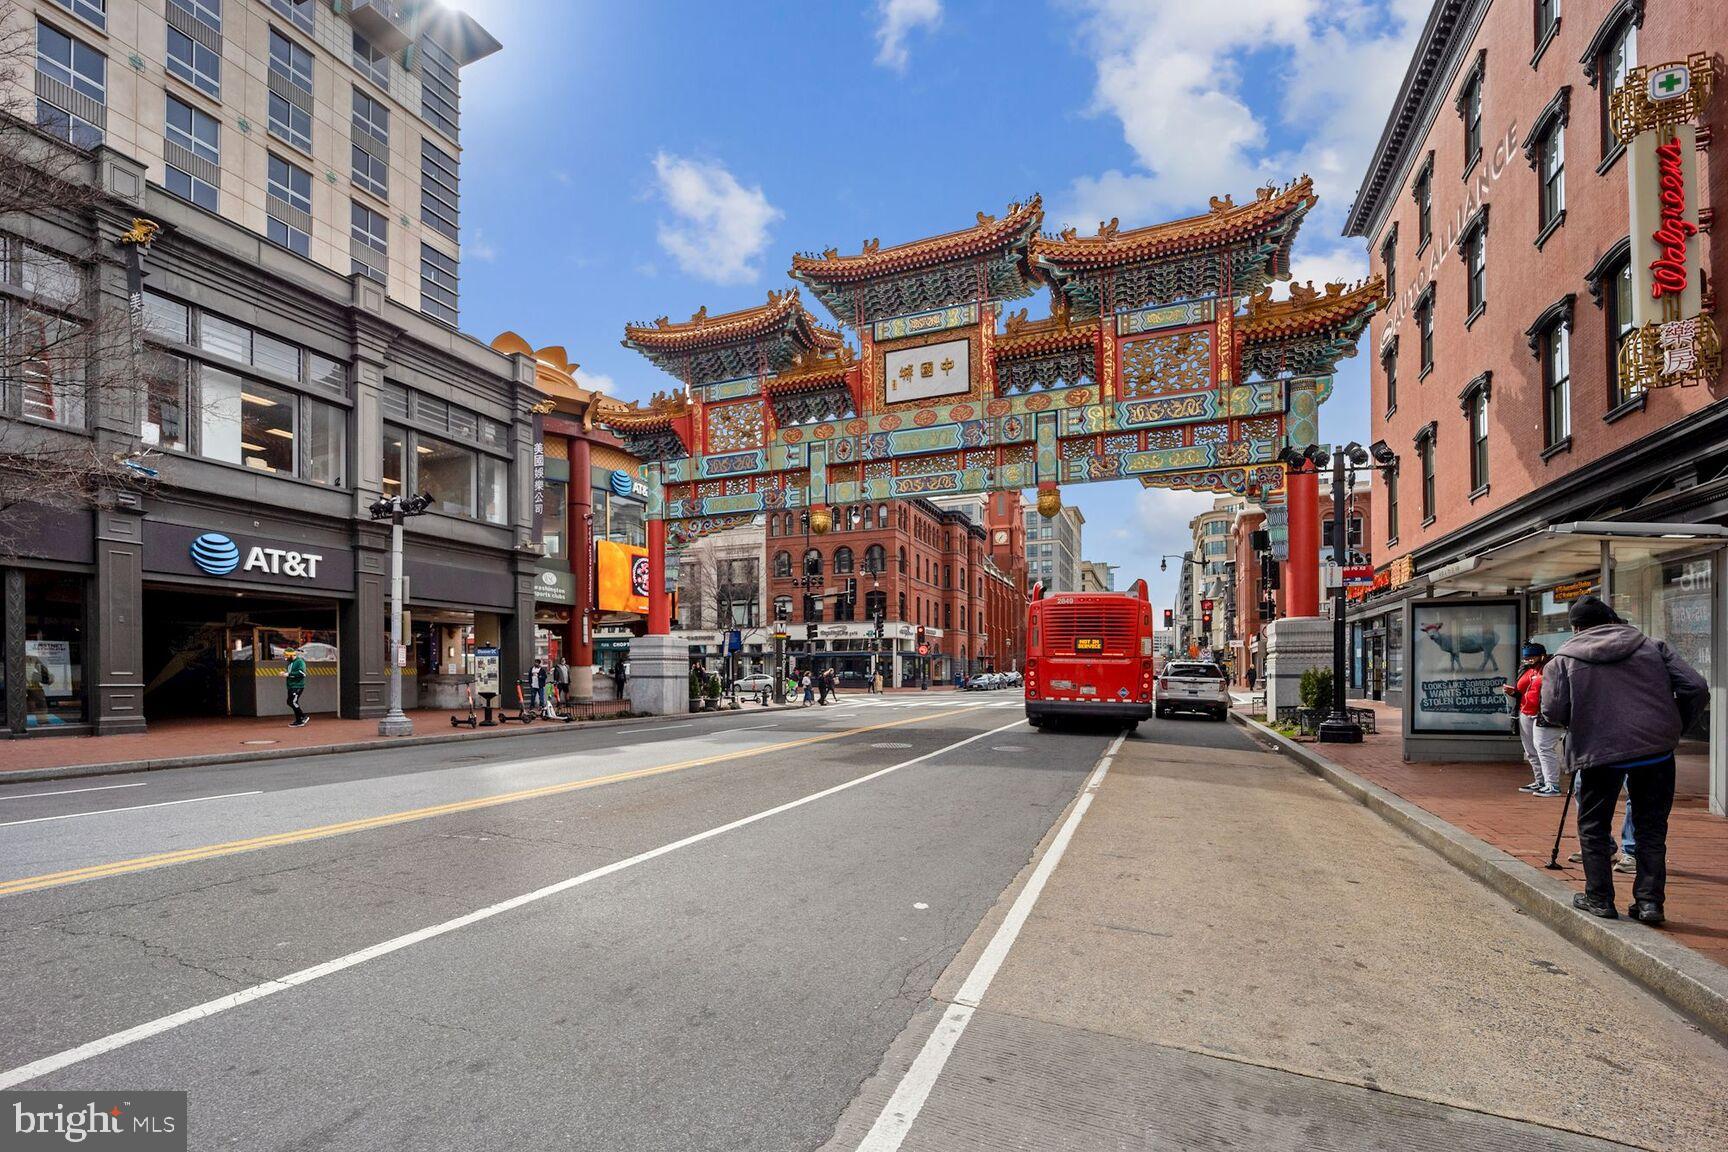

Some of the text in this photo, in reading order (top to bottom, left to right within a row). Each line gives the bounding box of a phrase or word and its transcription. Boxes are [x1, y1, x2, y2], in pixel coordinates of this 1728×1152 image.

[1429, 117, 1518, 283] ALLIANCE
[1649, 137, 1697, 299] Walgreens
[1661, 319, 1697, 375] 藥房
[243, 546, 323, 579] AT&T
[777, 623, 786, 633] M
[1423, 679, 1504, 690] LOOKS LIKE SOMEBODY
[1429, 686, 1490, 698] WANTS THEIR
[1423, 695, 1506, 707] STOLEN COAT BACK
